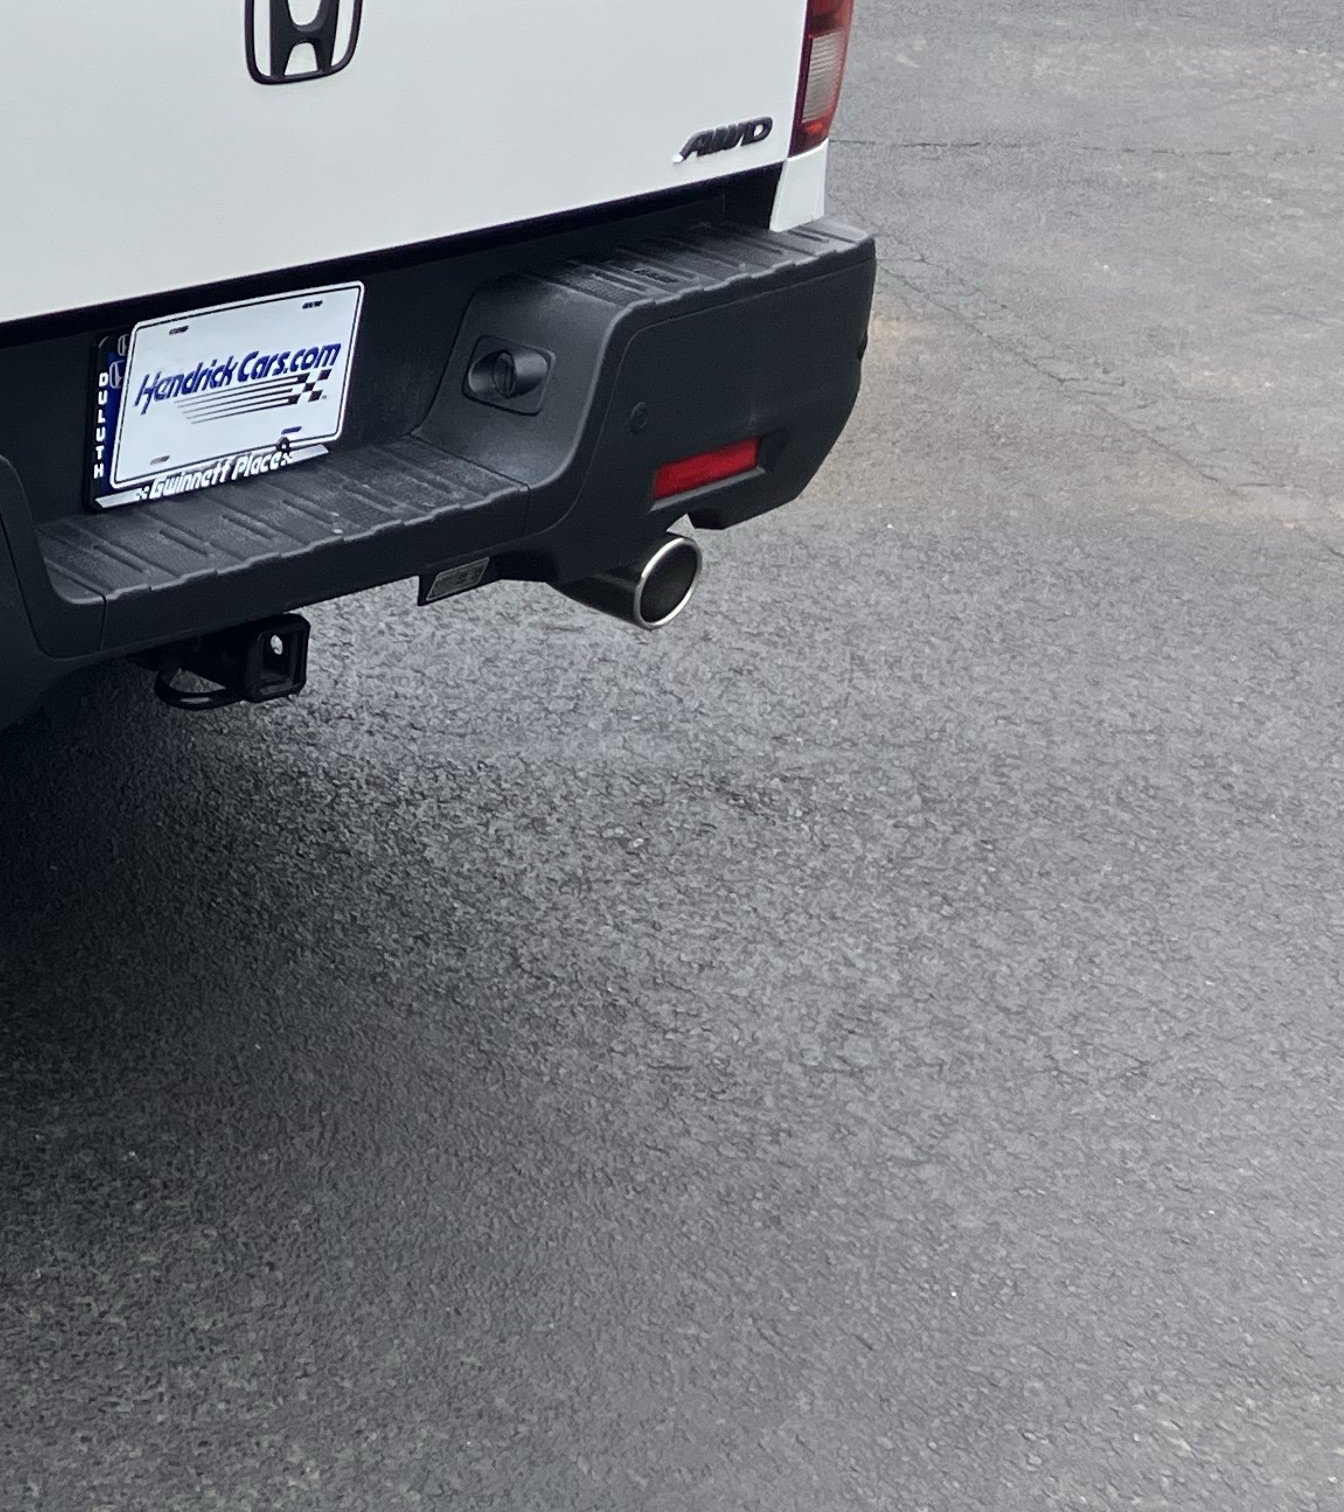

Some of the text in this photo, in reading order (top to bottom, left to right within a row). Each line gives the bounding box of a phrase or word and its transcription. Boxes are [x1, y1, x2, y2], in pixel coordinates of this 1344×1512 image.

[678, 115, 774, 161] AWD
[93, 372, 109, 479] DULUTH
[148, 450, 282, 500] Gwinnett Place
